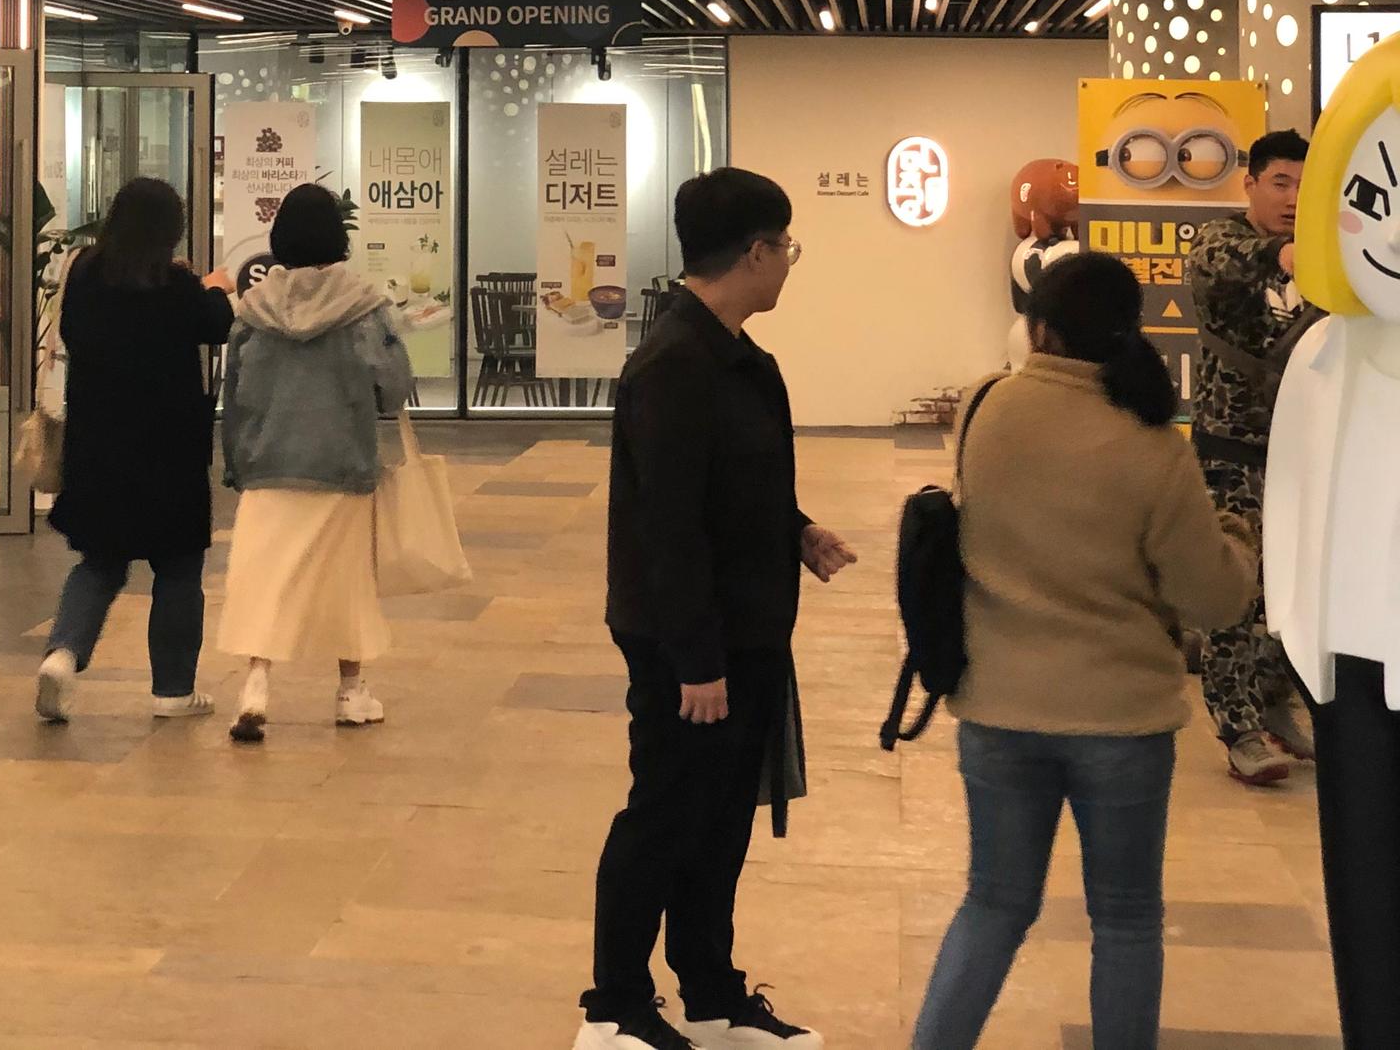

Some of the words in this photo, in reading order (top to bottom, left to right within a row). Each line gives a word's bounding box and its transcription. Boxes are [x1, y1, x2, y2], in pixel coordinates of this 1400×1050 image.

[424, 6, 502, 26] GRAND
[506, 4, 611, 25] OPENING
[275, 156, 294, 168] 커피
[369, 146, 442, 175] 내몸애
[544, 147, 618, 177] 설레는
[816, 171, 870, 188] 설레는
[368, 180, 444, 210] 애삼아
[544, 181, 619, 210] 디저트
[1088, 220, 1193, 255] 미니
[1120, 257, 1183, 286] 별전
